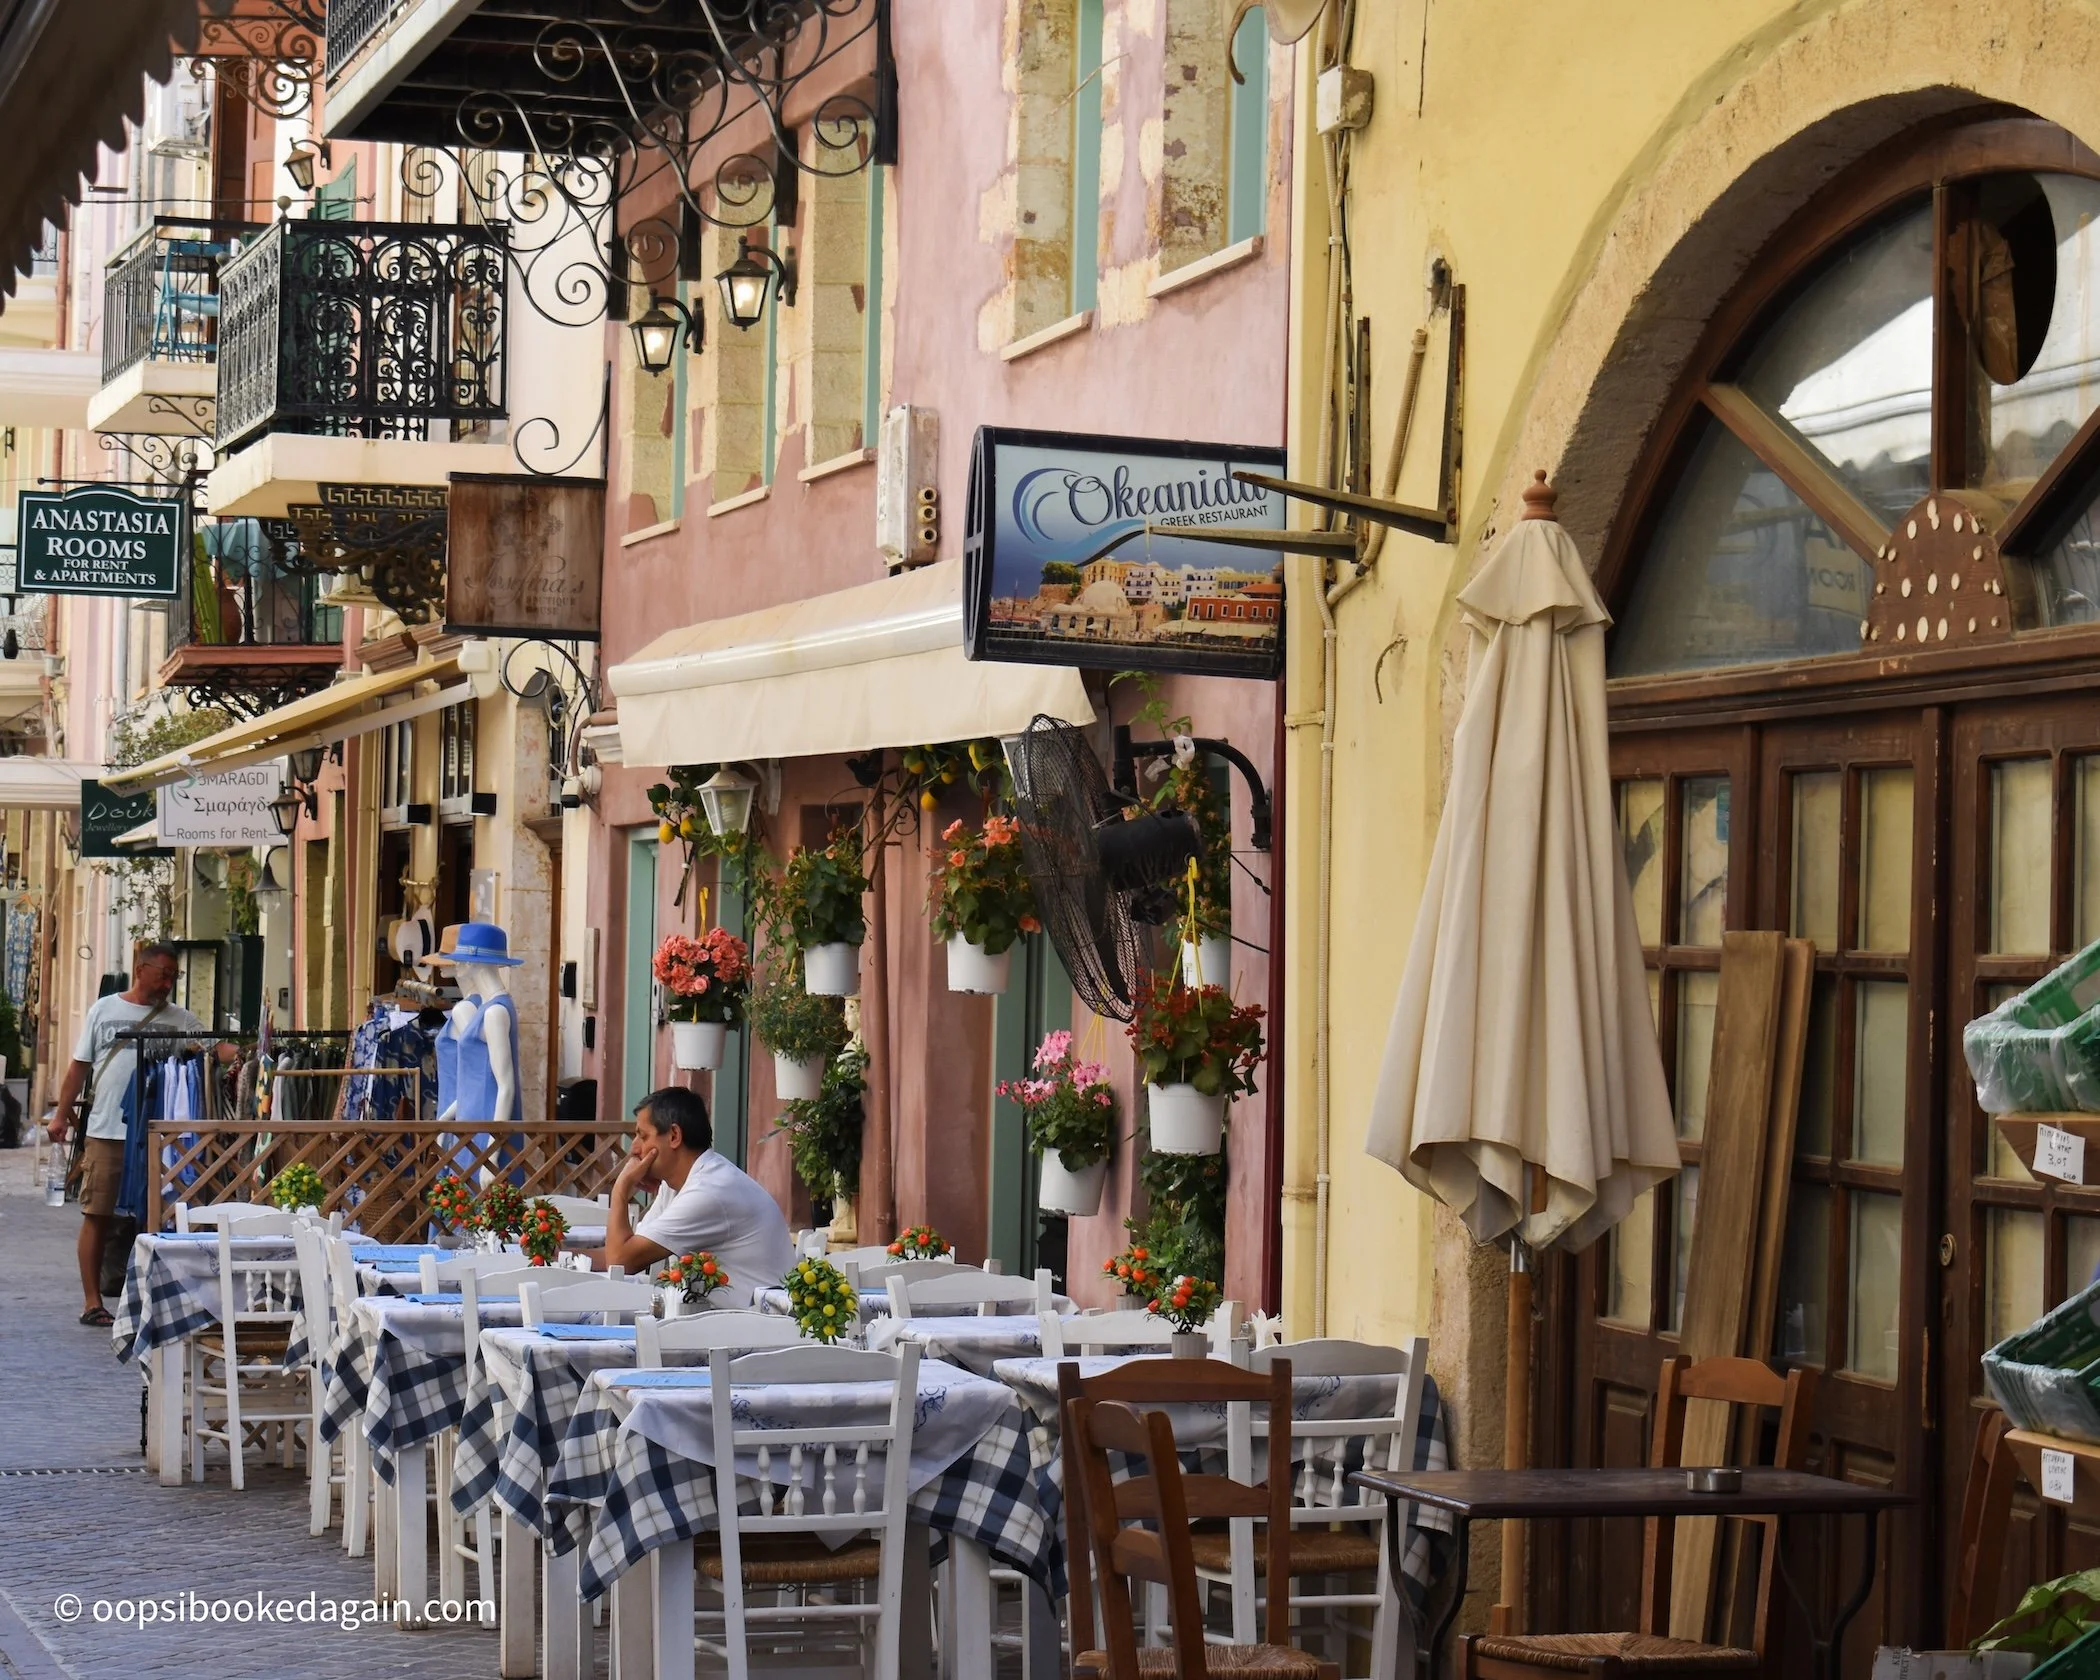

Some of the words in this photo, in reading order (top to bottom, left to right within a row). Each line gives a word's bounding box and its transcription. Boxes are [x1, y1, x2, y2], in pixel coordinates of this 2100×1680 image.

[31, 508, 170, 535] ANASTASIA
[1160, 514, 1197, 527] GREEK
[1198, 505, 1268, 525] RESTAURANT
[46, 537, 147, 560] ROOMS
[63, 558, 89, 569] FOR
[92, 560, 129, 571] RENT
[34, 569, 47, 581] &
[50, 570, 157, 585] APARTMENTS
[193, 797, 270, 816] Σμαράγδ
[177, 828, 216, 840] Rooms
[220, 827, 237, 839] for
[241, 827, 268, 839] Rent
